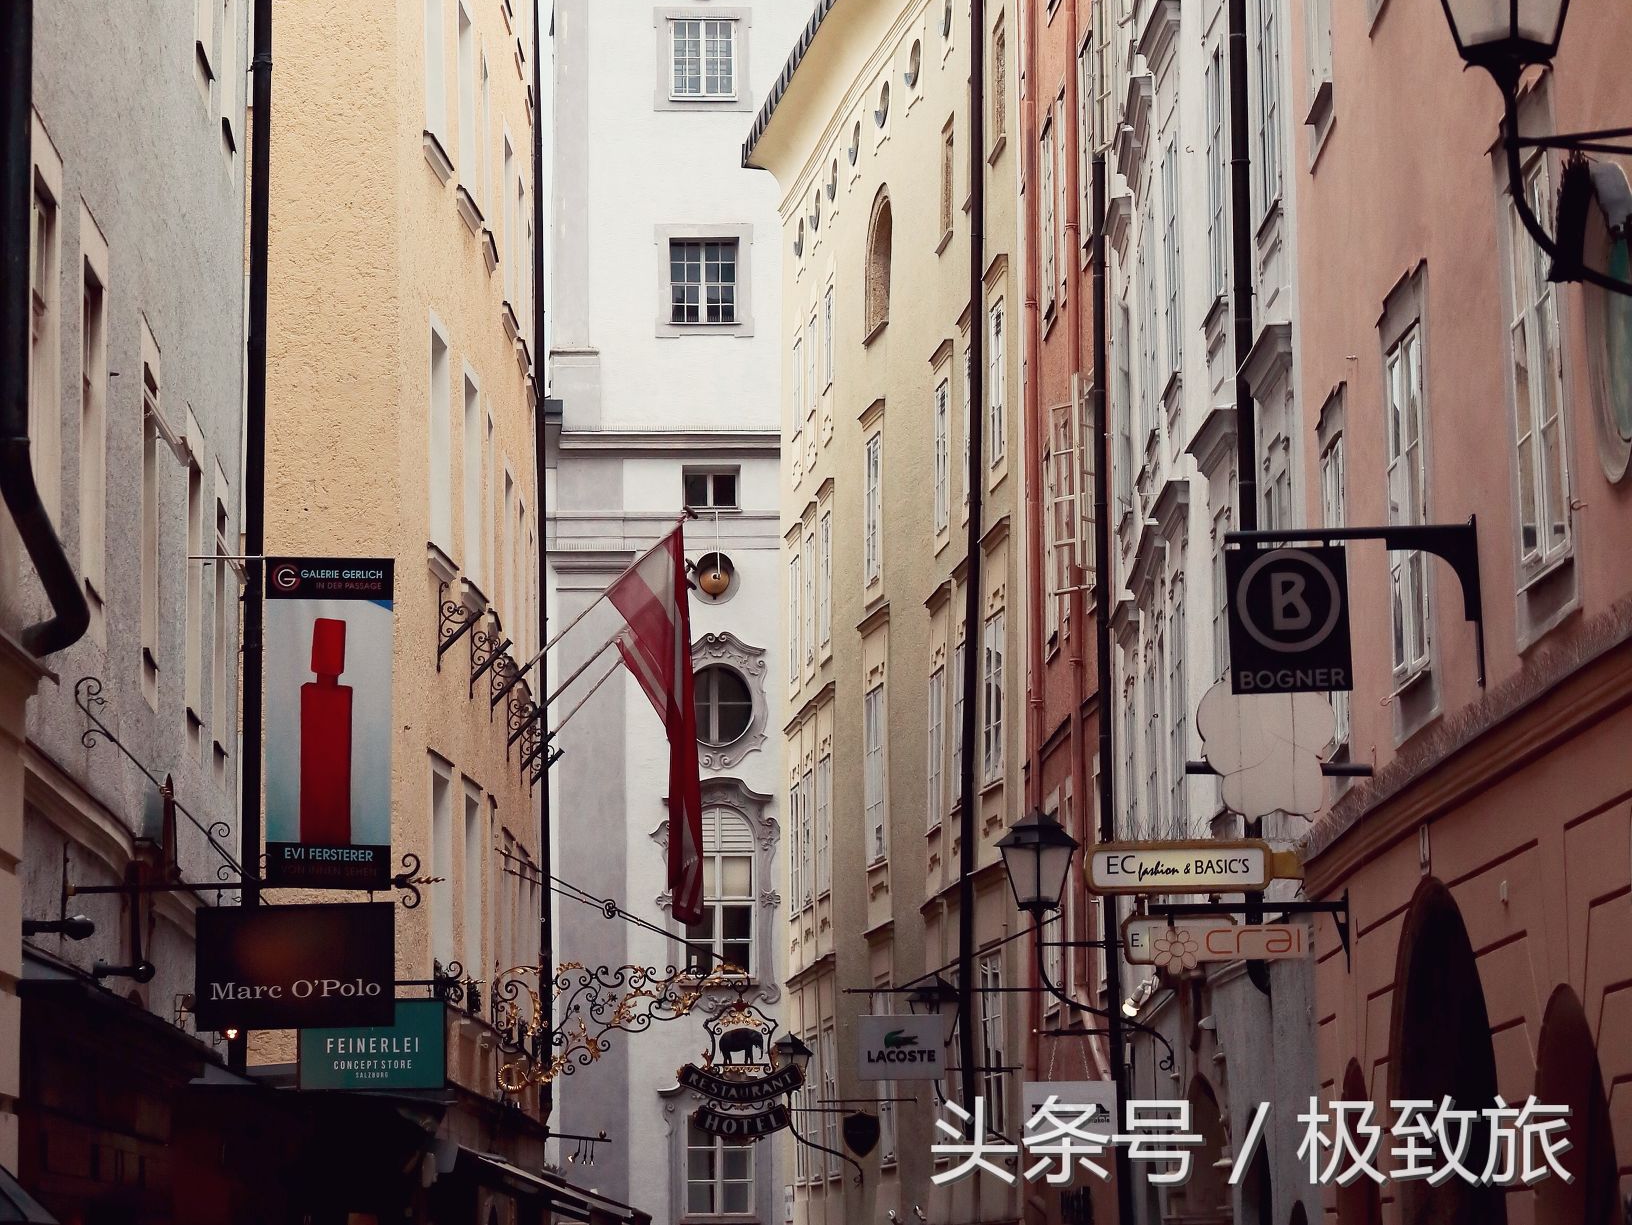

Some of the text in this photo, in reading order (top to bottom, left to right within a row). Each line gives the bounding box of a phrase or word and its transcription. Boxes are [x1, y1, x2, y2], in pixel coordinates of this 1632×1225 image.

[300, 569, 383, 579] GALERIE GERLICH
[316, 582, 382, 590] IN DER PASSAGE
[1270, 572, 1312, 631] B
[1239, 668, 1346, 690] BOGNER
[284, 847, 373, 862] EVI FERSTERER
[1107, 855, 1250, 882] EC fashion & BASIC'S
[210, 979, 381, 1000] Marc O'Polo
[326, 1037, 419, 1054] FEINERLEI
[333, 1059, 412, 1070] CONCEPT STORE
[867, 1049, 936, 1064] LACOSTE
[355, 1071, 389, 1079] SALZBURG
[688, 1072, 793, 1099] RESTAURANT
[704, 1112, 778, 1135] HOTEL
